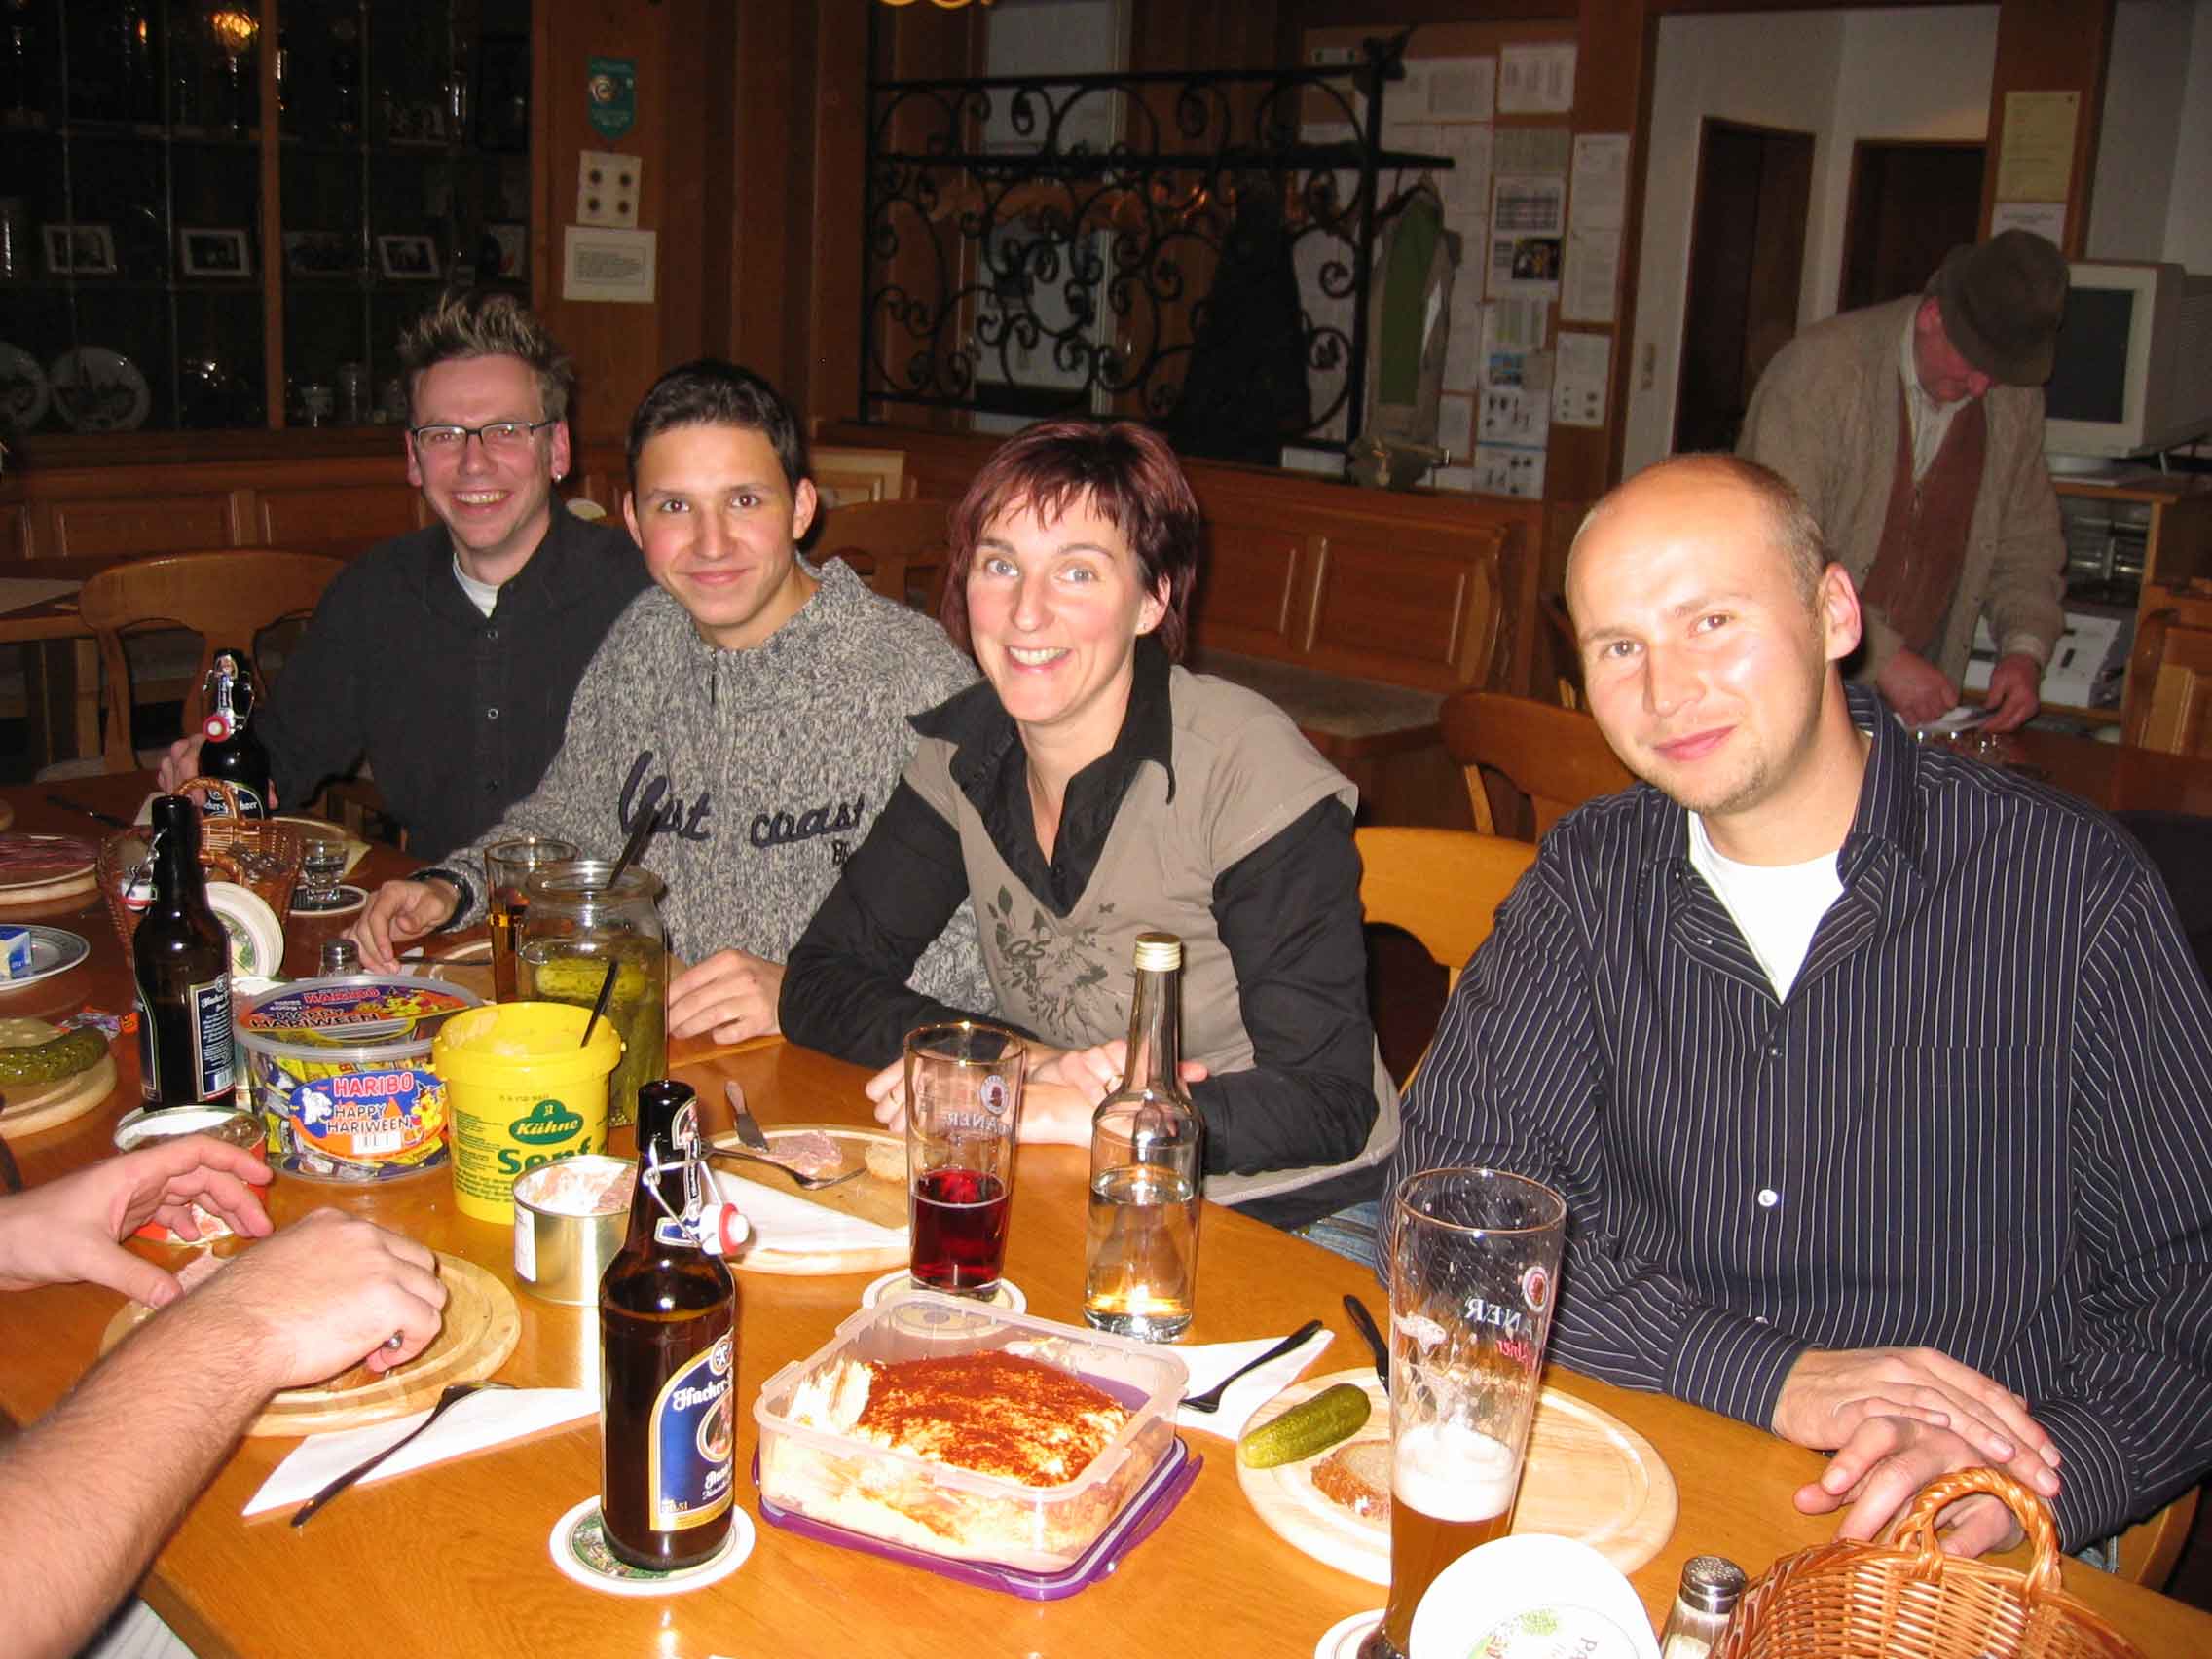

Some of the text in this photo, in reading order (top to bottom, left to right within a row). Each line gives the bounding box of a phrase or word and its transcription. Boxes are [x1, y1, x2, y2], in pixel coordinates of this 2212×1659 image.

[334, 1072, 414, 1097] HARIBO
[334, 1103, 386, 1119] HAPPY
[327, 1115, 411, 1133] HARIWEEN
[516, 1119, 579, 1136] Kühne
